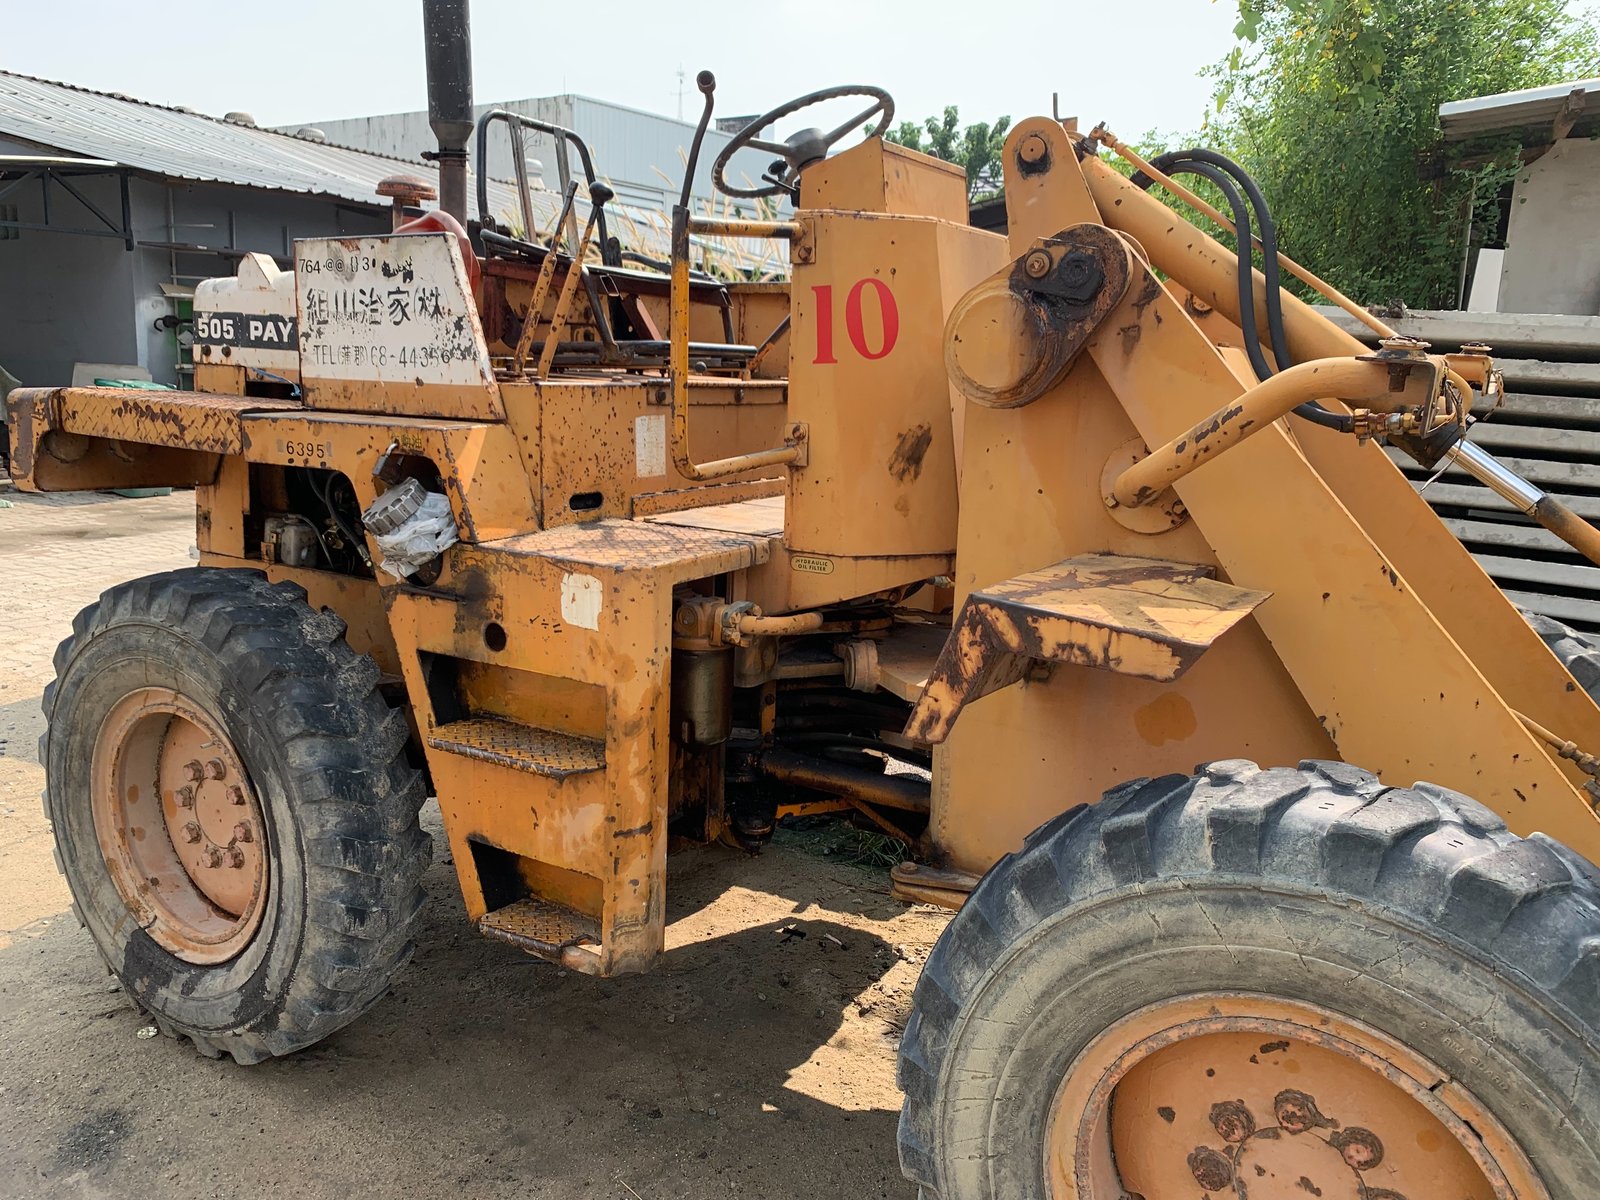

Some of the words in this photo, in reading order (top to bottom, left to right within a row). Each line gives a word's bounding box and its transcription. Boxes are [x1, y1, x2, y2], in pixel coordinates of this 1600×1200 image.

[198, 318, 234, 339] 505
[249, 320, 293, 343] PAY
[811, 278, 899, 364] 10
[286, 440, 325, 458] 6395
[795, 558, 828, 567] HYDRAULIC
